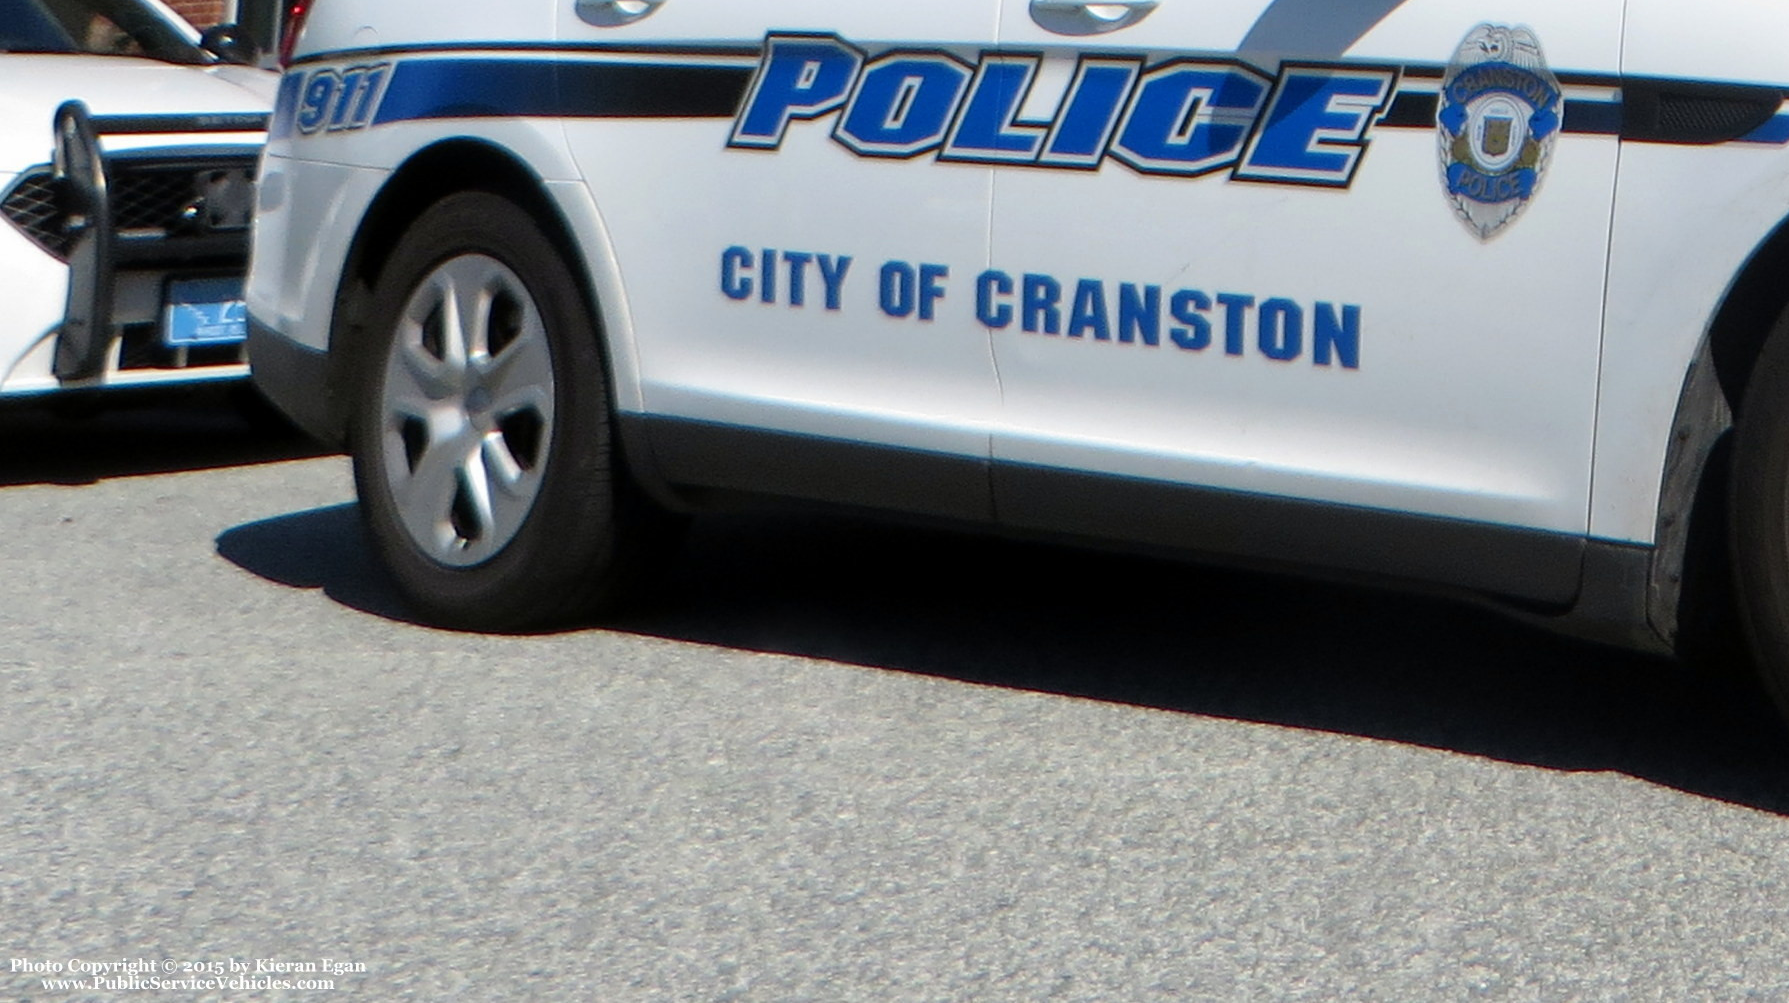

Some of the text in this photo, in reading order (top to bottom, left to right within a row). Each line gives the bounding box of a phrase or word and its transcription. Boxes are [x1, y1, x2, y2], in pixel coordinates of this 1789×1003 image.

[296, 62, 393, 135] 911
[726, 31, 1397, 188] POLICE
[1453, 68, 1551, 110] CRANSTON
[1457, 168, 1523, 199] POLICE
[720, 245, 1362, 370] CITY OF CRANSTON
